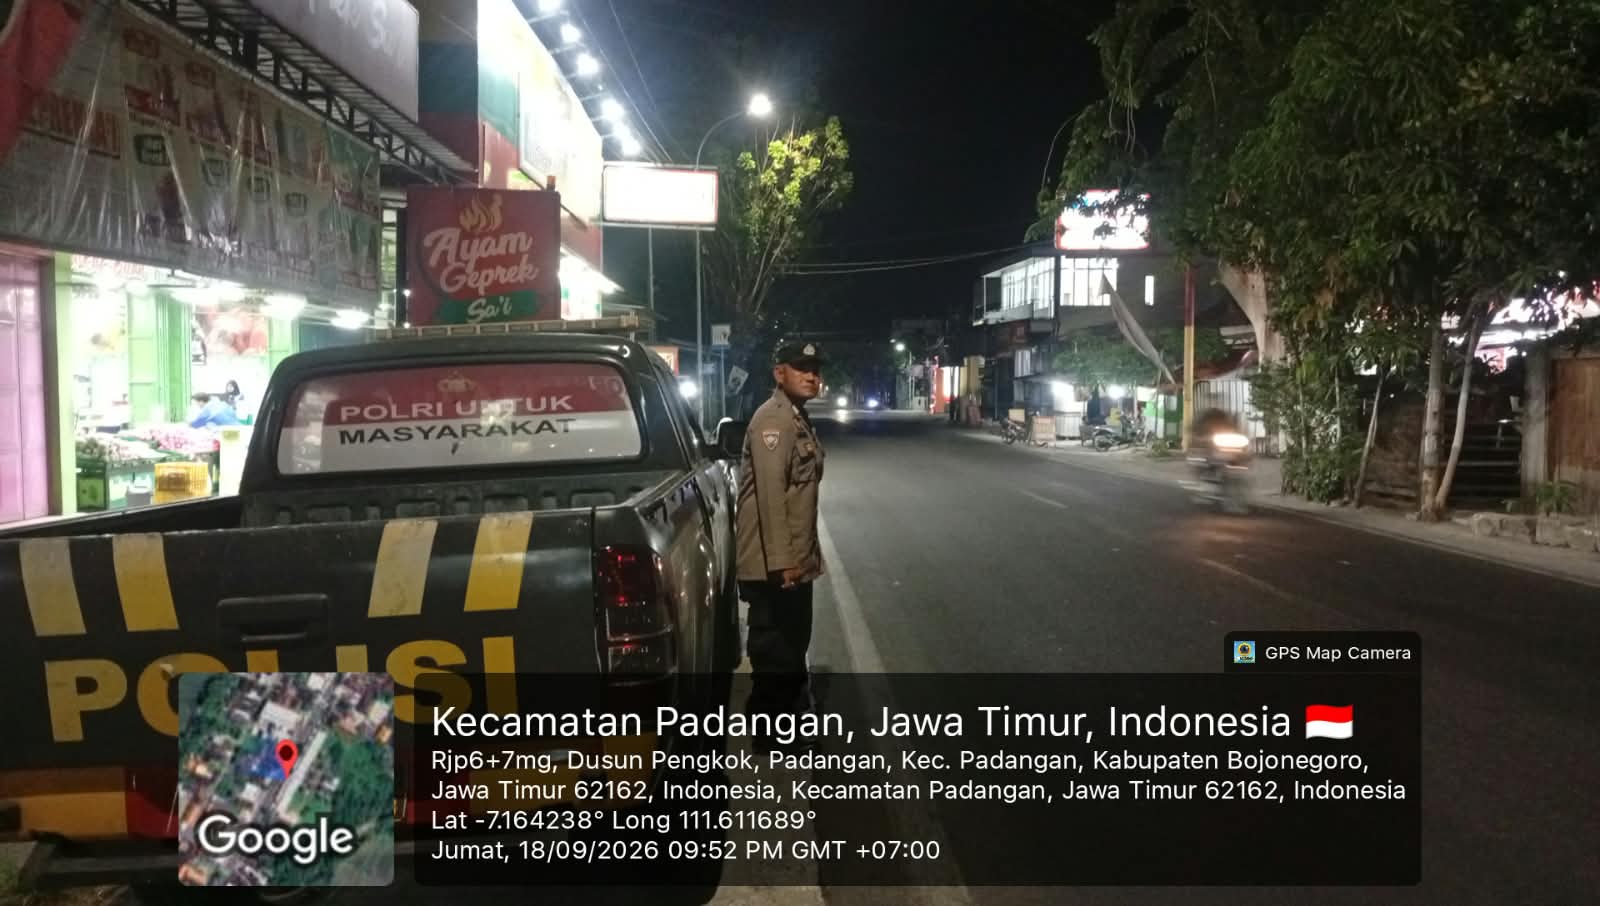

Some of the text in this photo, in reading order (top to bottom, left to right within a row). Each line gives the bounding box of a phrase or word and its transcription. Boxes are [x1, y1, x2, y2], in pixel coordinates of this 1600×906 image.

[424, 227, 533, 273] Ayam
[440, 254, 539, 296] Geprek
[340, 402, 443, 422] POLRI
[340, 418, 577, 445] MASYARAKAT
